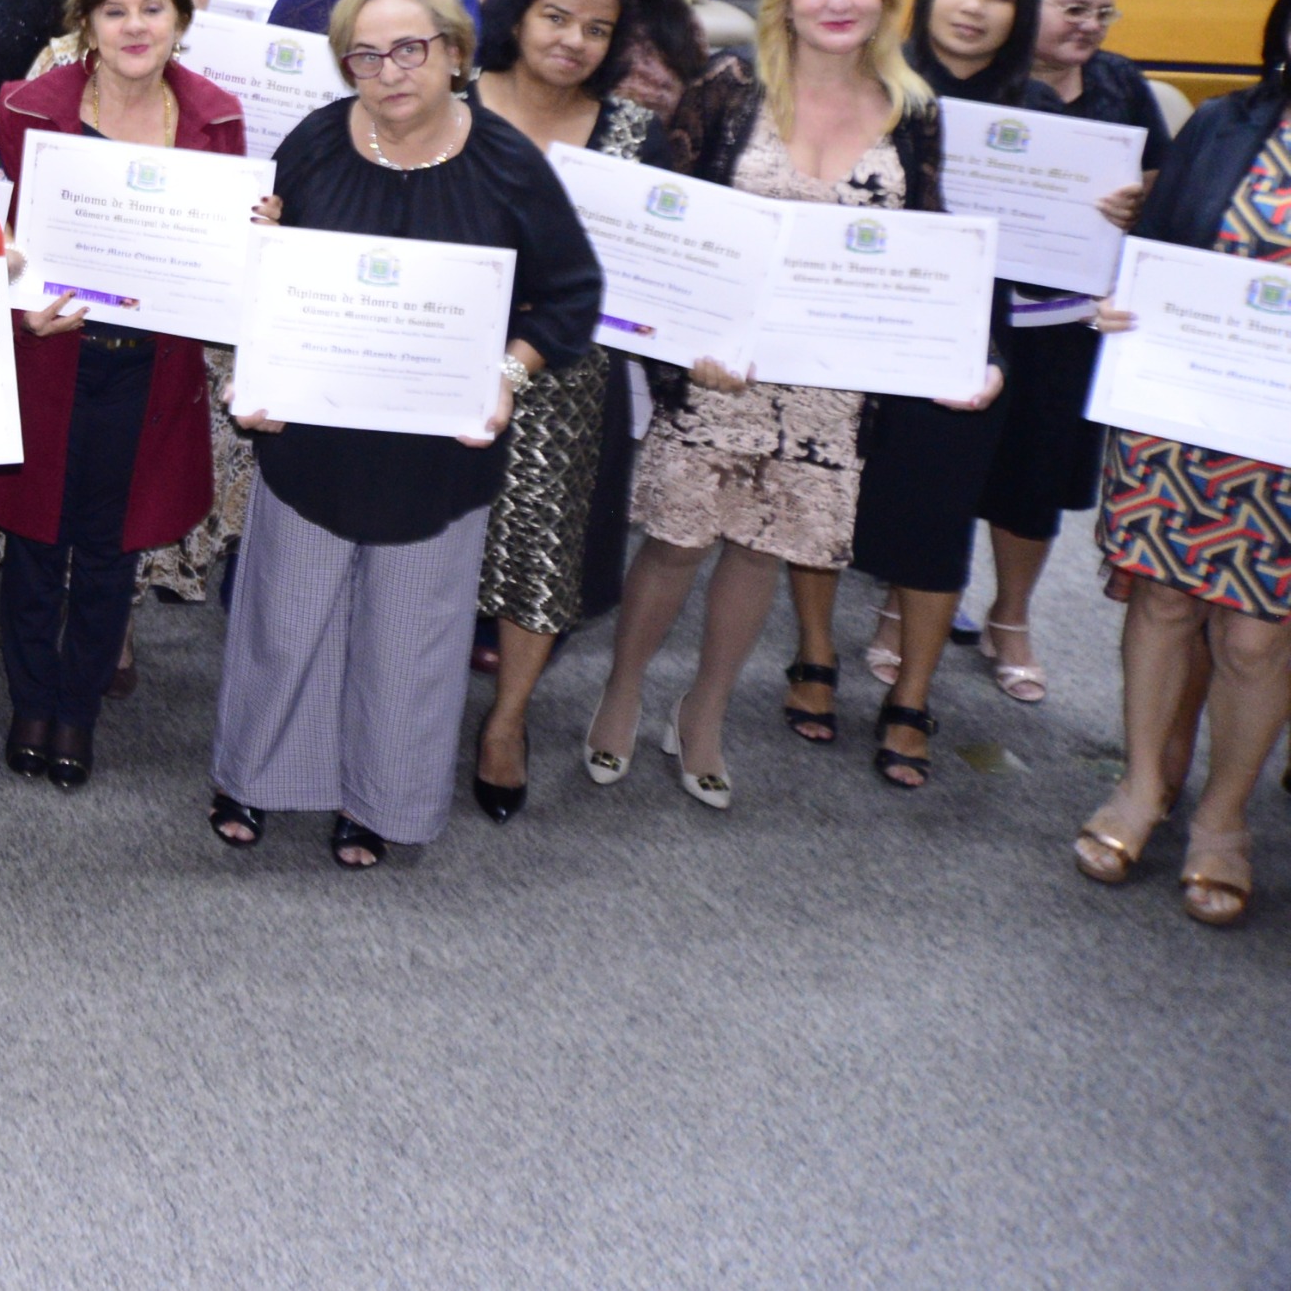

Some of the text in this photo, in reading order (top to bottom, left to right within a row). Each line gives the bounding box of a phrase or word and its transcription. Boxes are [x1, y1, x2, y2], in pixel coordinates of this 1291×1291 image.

[203, 67, 317, 98] Diploma de Honra ao
[61, 189, 227, 222] Diploma de Honra ao Mérito
[75, 209, 208, 235] Câmara Municipal de Goiânia
[287, 286, 465, 316] Diploma de Honra ao Mérito
[302, 306, 340, 317] Câmara
[344, 310, 391, 323] Municipal
[395, 315, 405, 324] de
[408, 318, 445, 329] Goiânia
